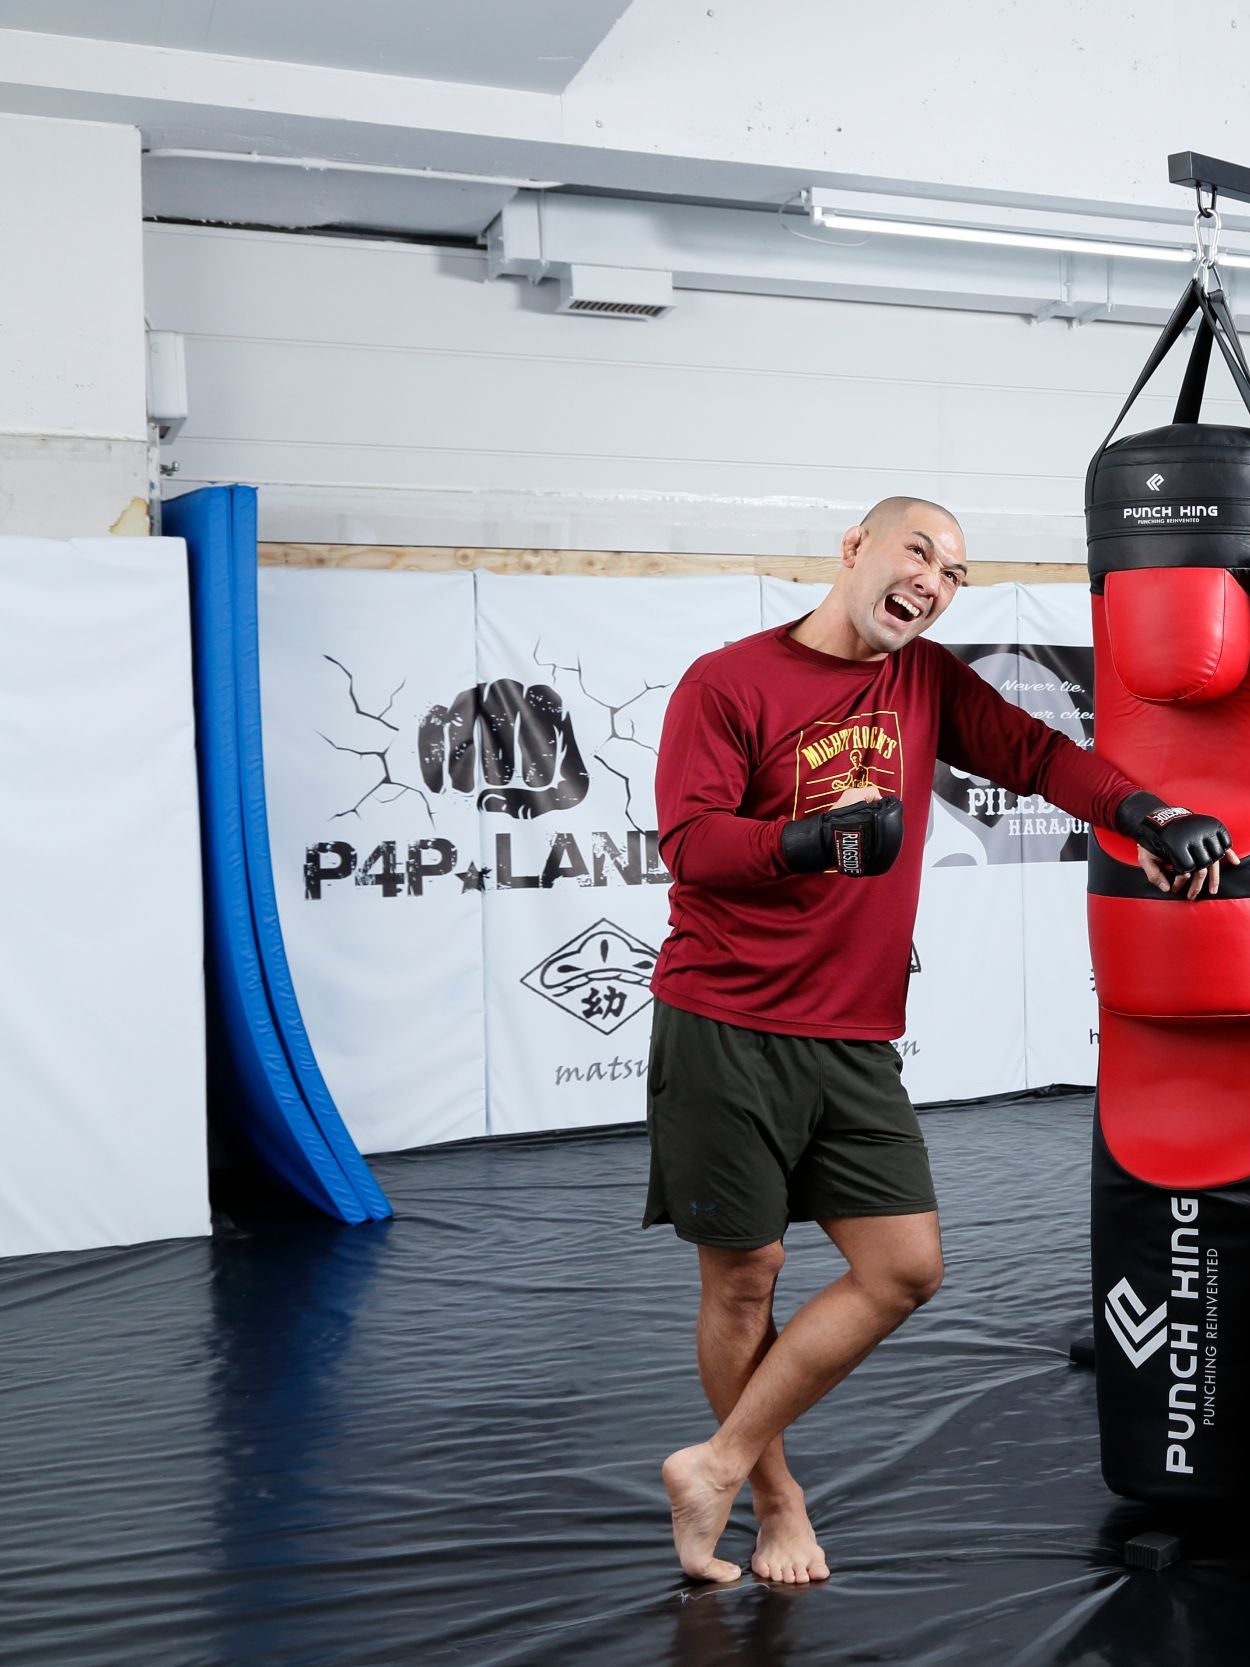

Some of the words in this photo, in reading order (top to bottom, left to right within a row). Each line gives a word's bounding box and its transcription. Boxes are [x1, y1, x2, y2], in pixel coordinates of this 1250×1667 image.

[1123, 506, 1172, 519] PUNCH
[1180, 505, 1218, 517] KING
[1000, 679, 1056, 692] Never
[1060, 680, 1086, 693] lie.
[801, 727, 854, 770] MIGHTY
[852, 725, 898, 760] ROCK'S
[304, 838, 458, 900] P4P
[842, 833, 860, 874] RINGSIDE
[1170, 1197, 1200, 1299] KING
[1206, 1248, 1219, 1339] REINVENTED
[1166, 1322, 1199, 1474] PUNCH
[1203, 1346, 1217, 1426] PUNCHING
